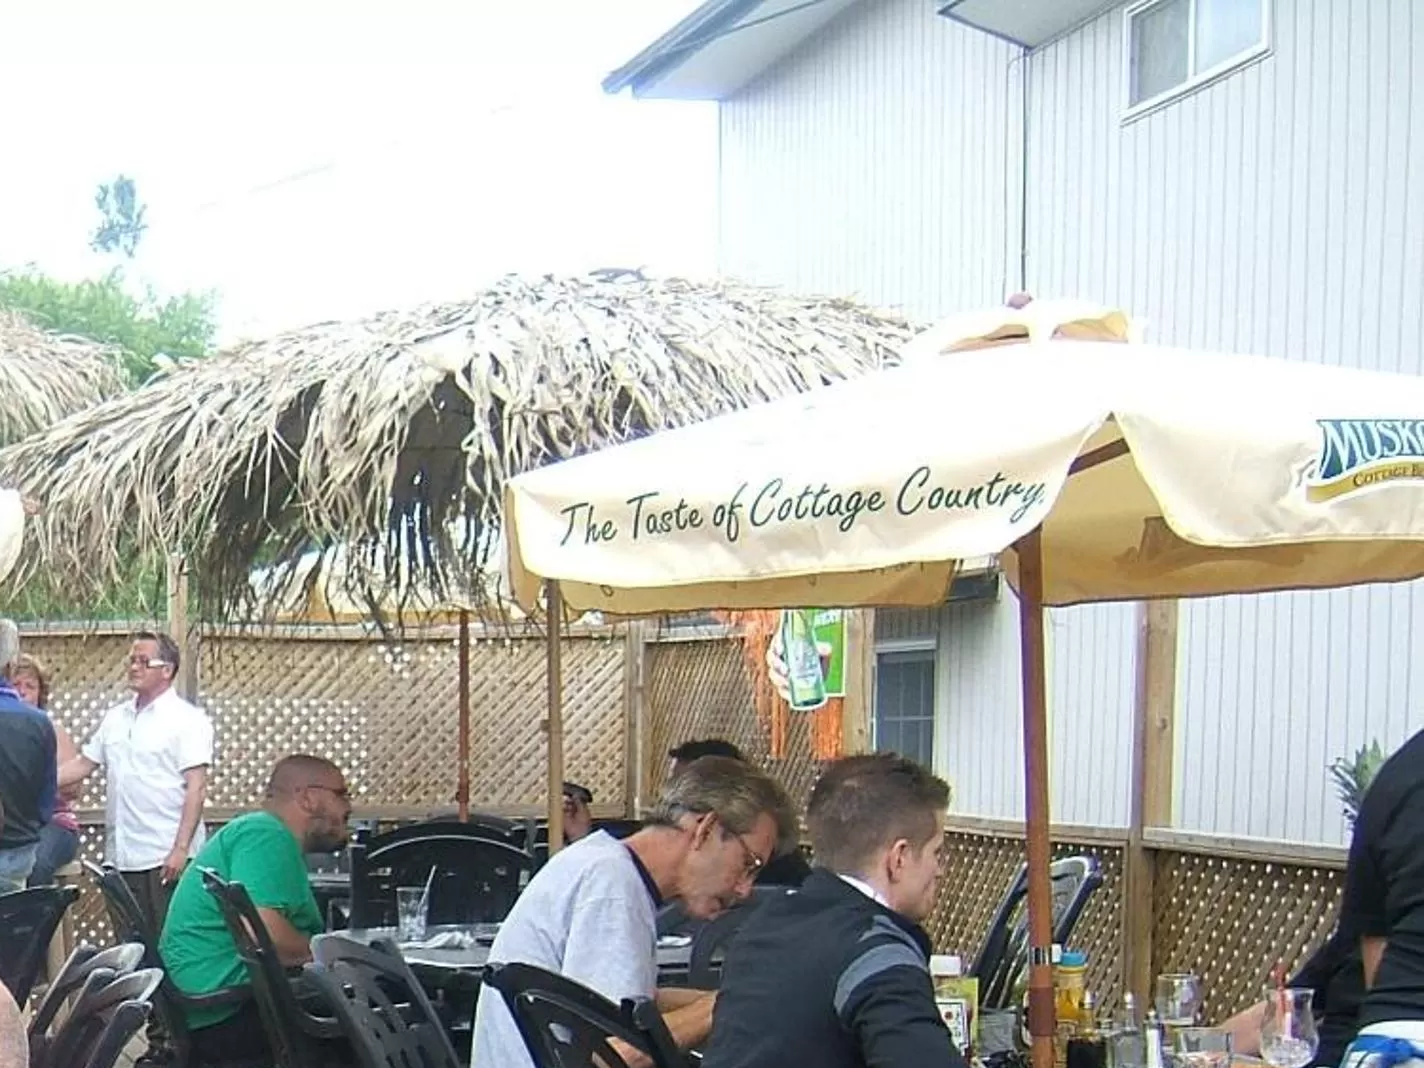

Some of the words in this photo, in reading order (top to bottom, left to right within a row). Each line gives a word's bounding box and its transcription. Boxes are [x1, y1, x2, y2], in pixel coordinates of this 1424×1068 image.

[1319, 420, 1424, 480] MUSK
[560, 502, 616, 546] The
[627, 491, 704, 540] Taste
[713, 482, 747, 543] of
[750, 478, 885, 531] Cottage
